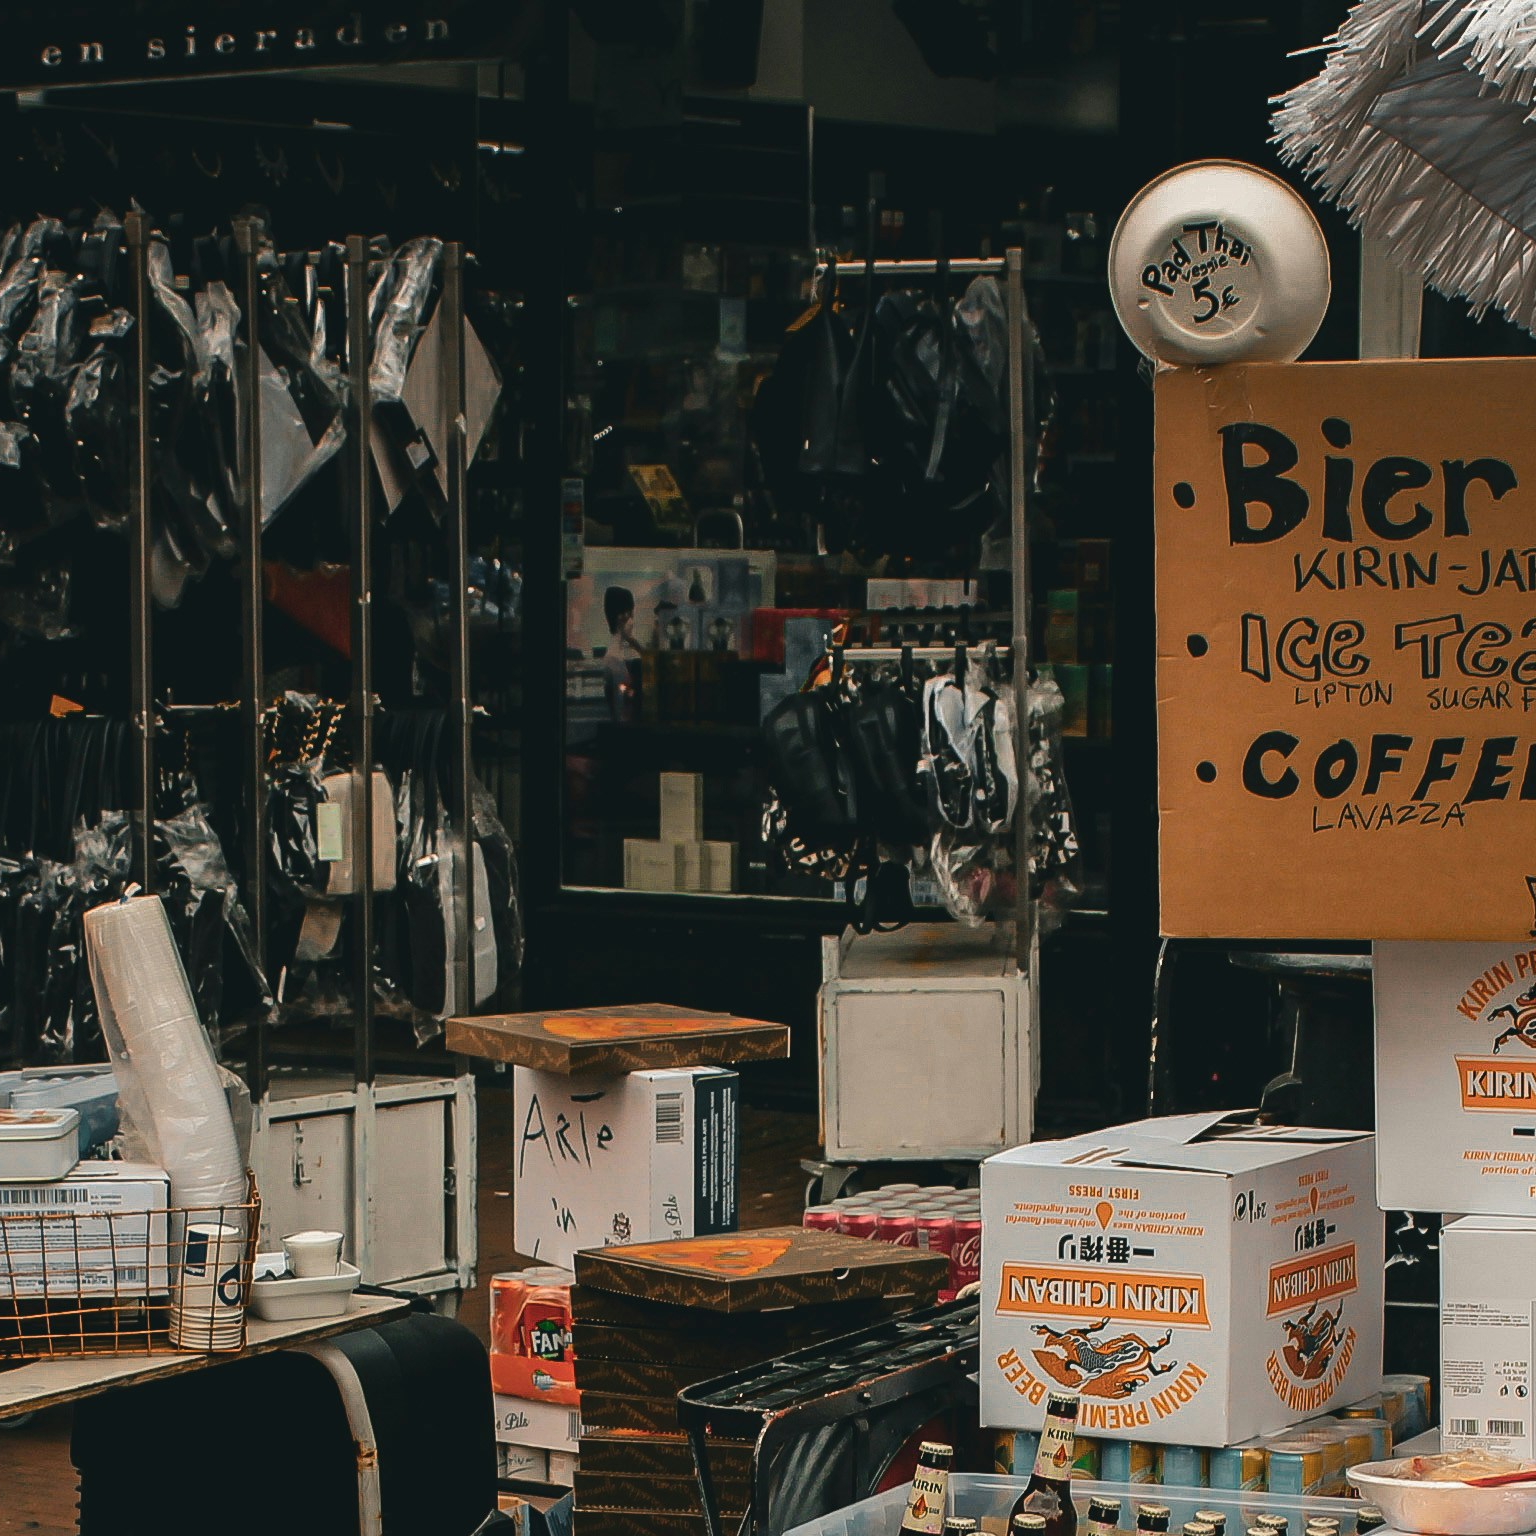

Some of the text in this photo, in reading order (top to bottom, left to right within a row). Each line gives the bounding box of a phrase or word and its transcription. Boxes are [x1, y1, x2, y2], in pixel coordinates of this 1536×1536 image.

[41, 38, 104, 65] en
[147, 13, 451, 61] sieraden
[1141, 220, 1252, 296] Pad Thai
[1180, 253, 1229, 282] veggie
[1219, 417, 1517, 546] Bier
[1293, 680, 1394, 707] LIPTON
[1427, 685, 1512, 711] SUGAR
[1311, 803, 1466, 833] LAVAZZA
[1456, 961, 1514, 1022] KIRIN
[1068, 1185, 1140, 1201] FIRST PRESS
[1009, 1275, 1201, 1315] KIRIN ICHIBAN
[1273, 1256, 1355, 1304] KIRIN ICHIBAN
[996, 1347, 1208, 1430] KIRIN PREMI BEER
